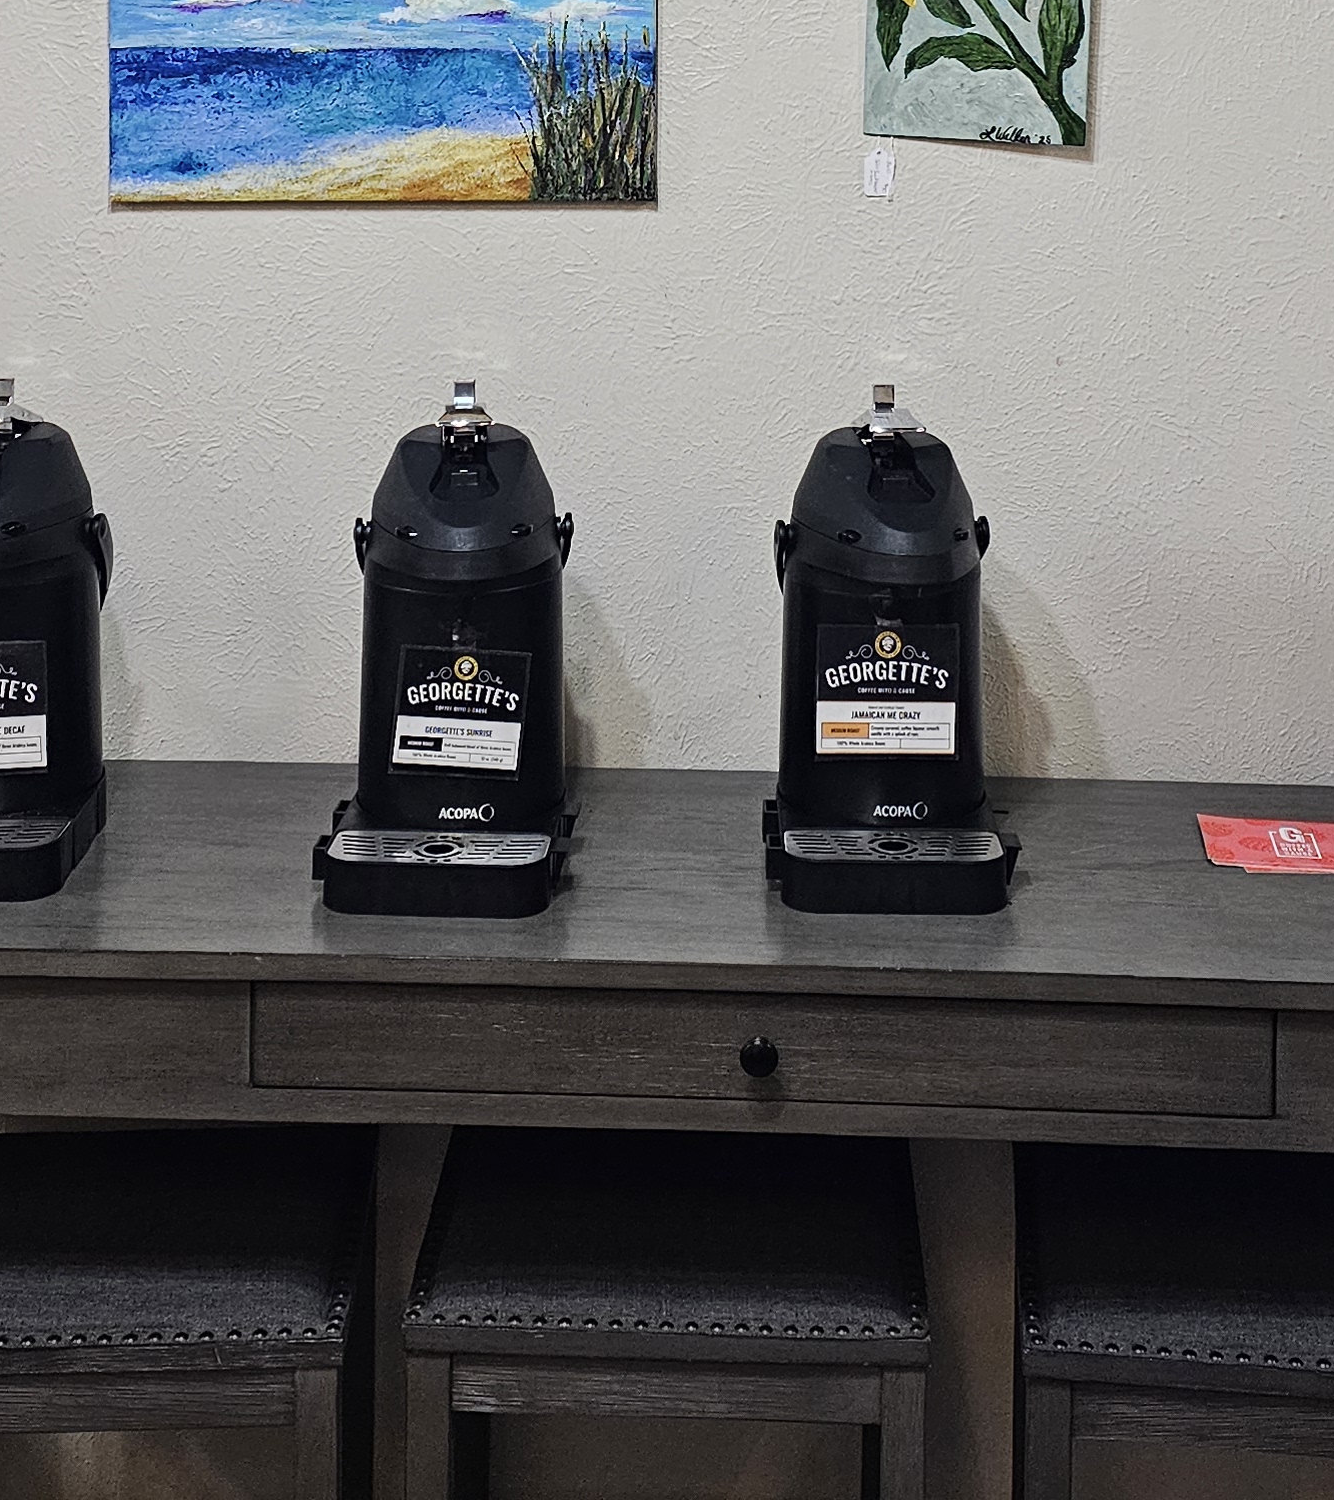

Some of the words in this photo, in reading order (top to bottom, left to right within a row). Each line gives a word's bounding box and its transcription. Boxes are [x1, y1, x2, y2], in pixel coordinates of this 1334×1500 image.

[825, 661, 949, 689] GEORGETTE'S
[407, 682, 519, 711] GEORGETTE'S
[851, 711, 885, 720] JAMAICAN
[887, 711, 896, 719] ME
[899, 711, 921, 720] CRAZY
[4, 725, 25, 734] DECAF
[425, 726, 465, 736] GEORGETTE'S
[467, 729, 493, 738] SUNRISE
